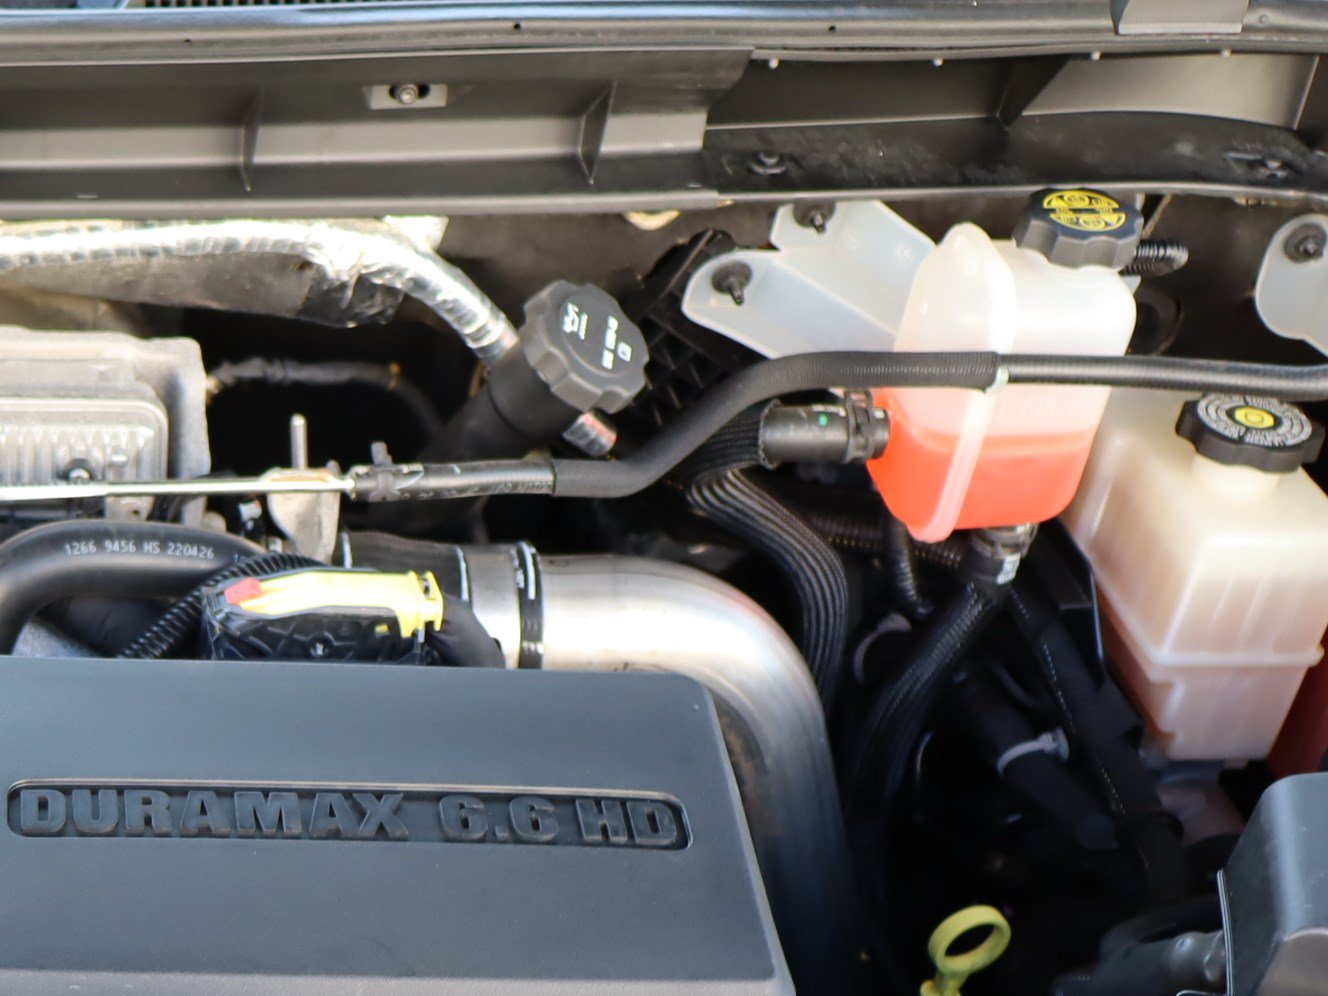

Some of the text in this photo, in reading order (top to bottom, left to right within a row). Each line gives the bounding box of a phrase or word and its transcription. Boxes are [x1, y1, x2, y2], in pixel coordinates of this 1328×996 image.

[65, 541, 97, 555] 1266
[104, 539, 137, 554] 9456
[143, 541, 161, 555] HS
[167, 543, 215, 560] 220426
[20, 789, 678, 846] DURAMAX 6.6 HD
